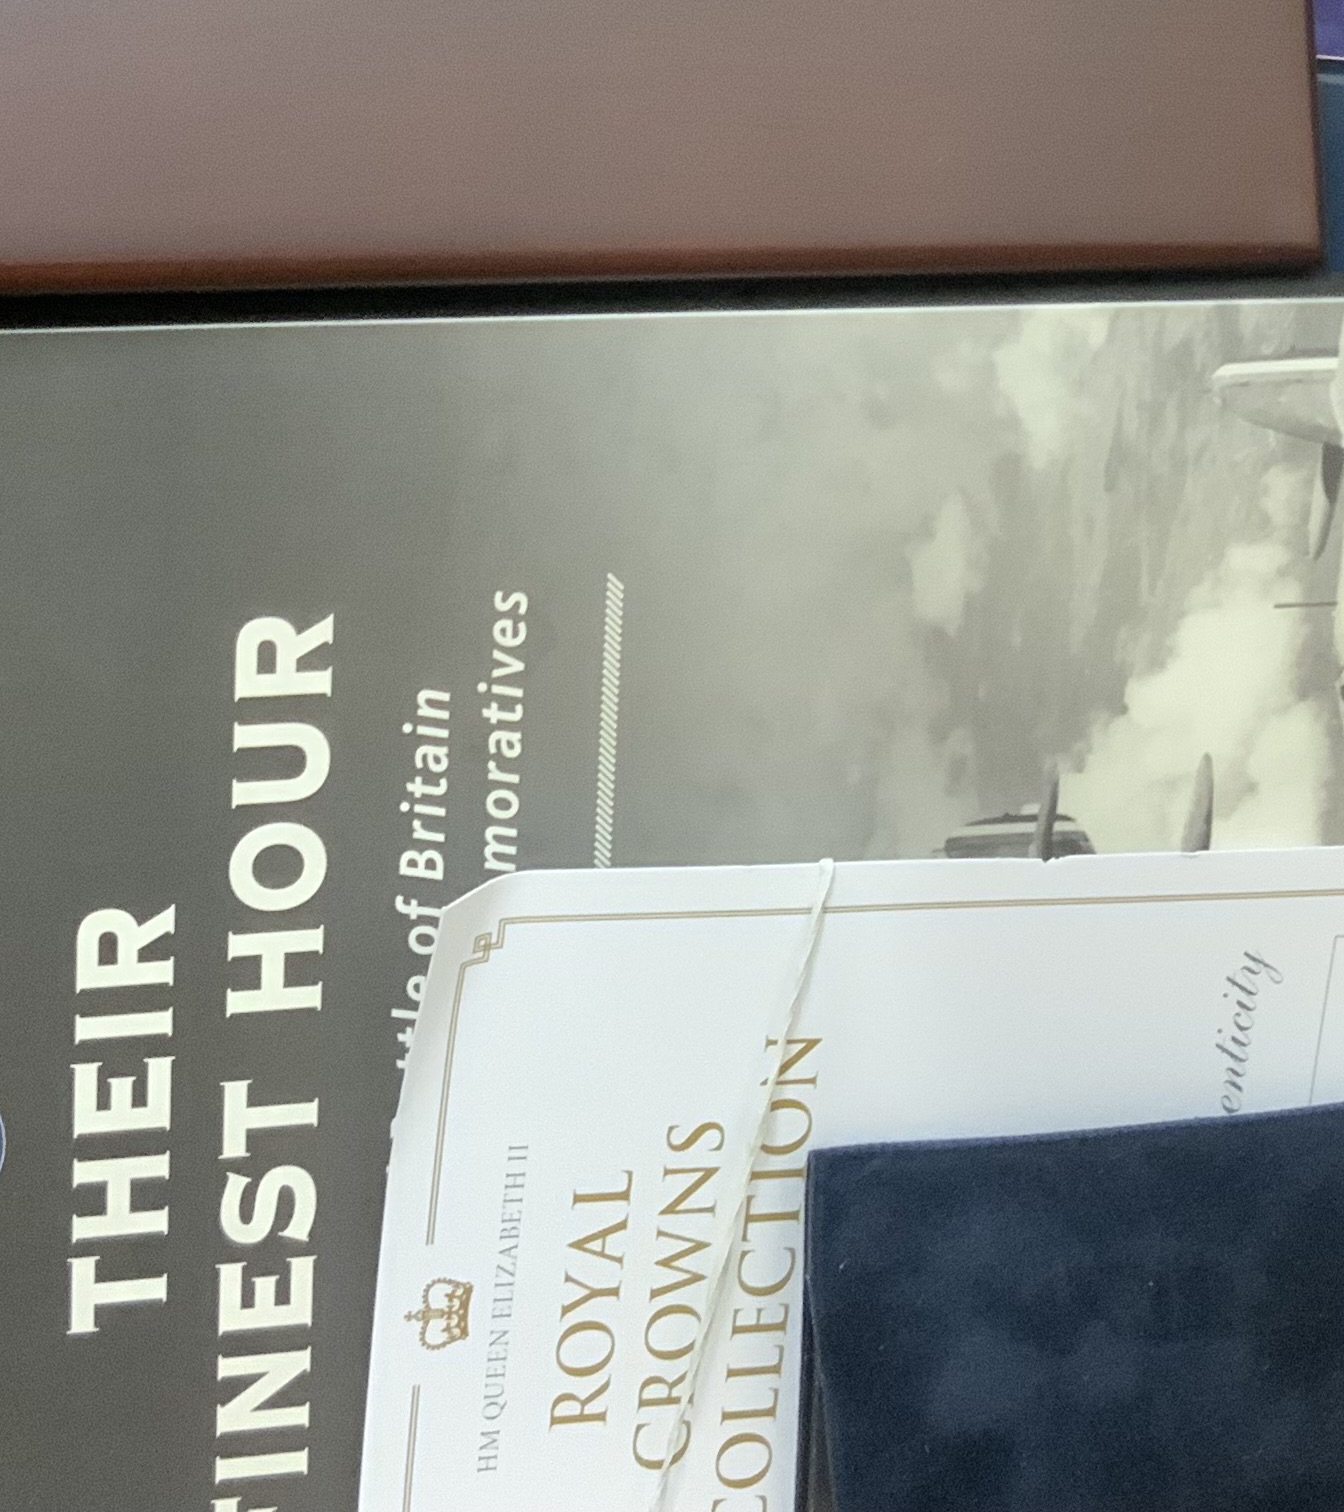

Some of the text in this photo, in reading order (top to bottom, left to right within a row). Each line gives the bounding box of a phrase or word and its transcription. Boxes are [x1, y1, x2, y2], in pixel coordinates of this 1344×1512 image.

[225, 612, 336, 1018] HOUR
[394, 894, 445, 956] of
[398, 688, 451, 881] Britain
[66, 903, 177, 1335] THEIR
[476, 1143, 530, 1475] HM QUEEN ELIZABETH II
[549, 1168, 634, 1432] ROYAL
[632, 1120, 726, 1472] CROWNS
